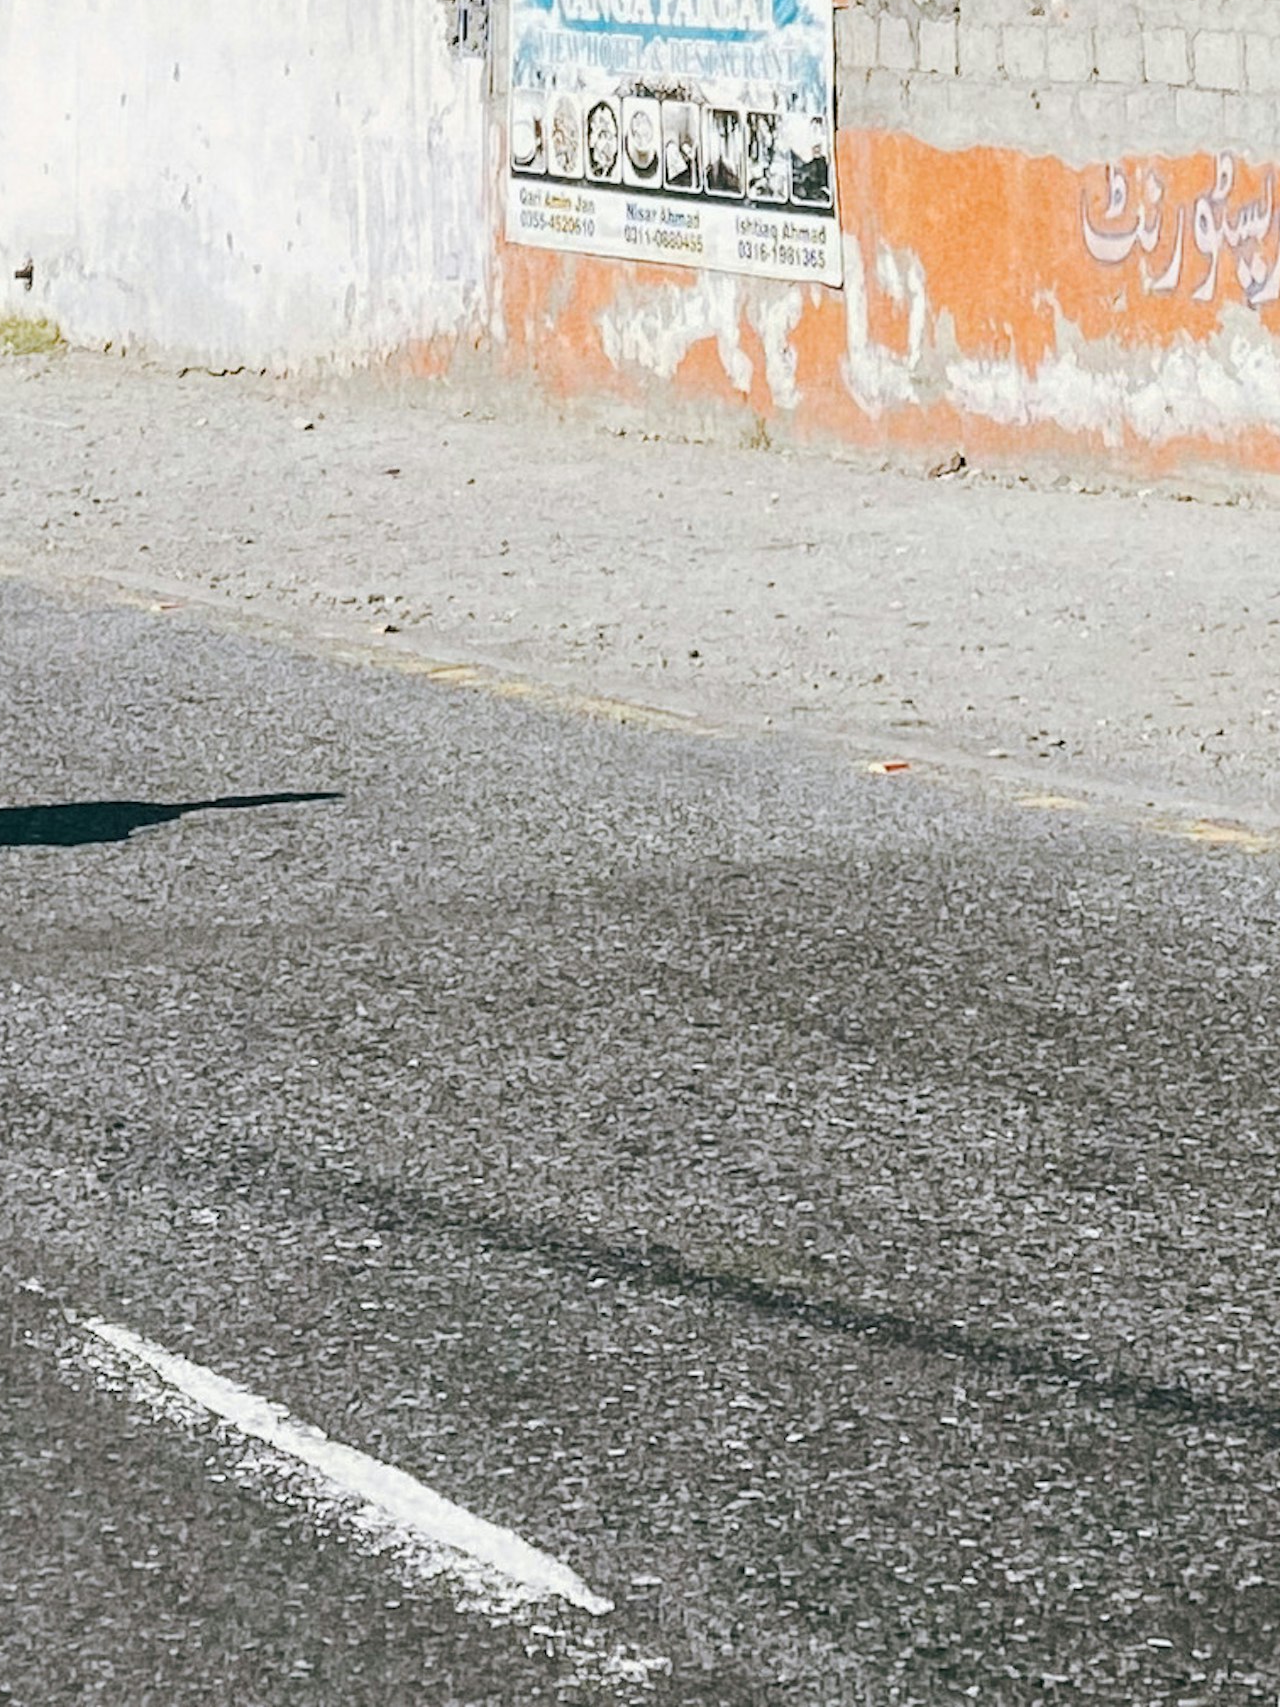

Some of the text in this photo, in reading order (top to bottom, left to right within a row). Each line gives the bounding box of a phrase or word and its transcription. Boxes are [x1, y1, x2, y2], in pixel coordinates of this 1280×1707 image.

[537, 31, 797, 83] VIEW HOTEL & RESTAURANT
